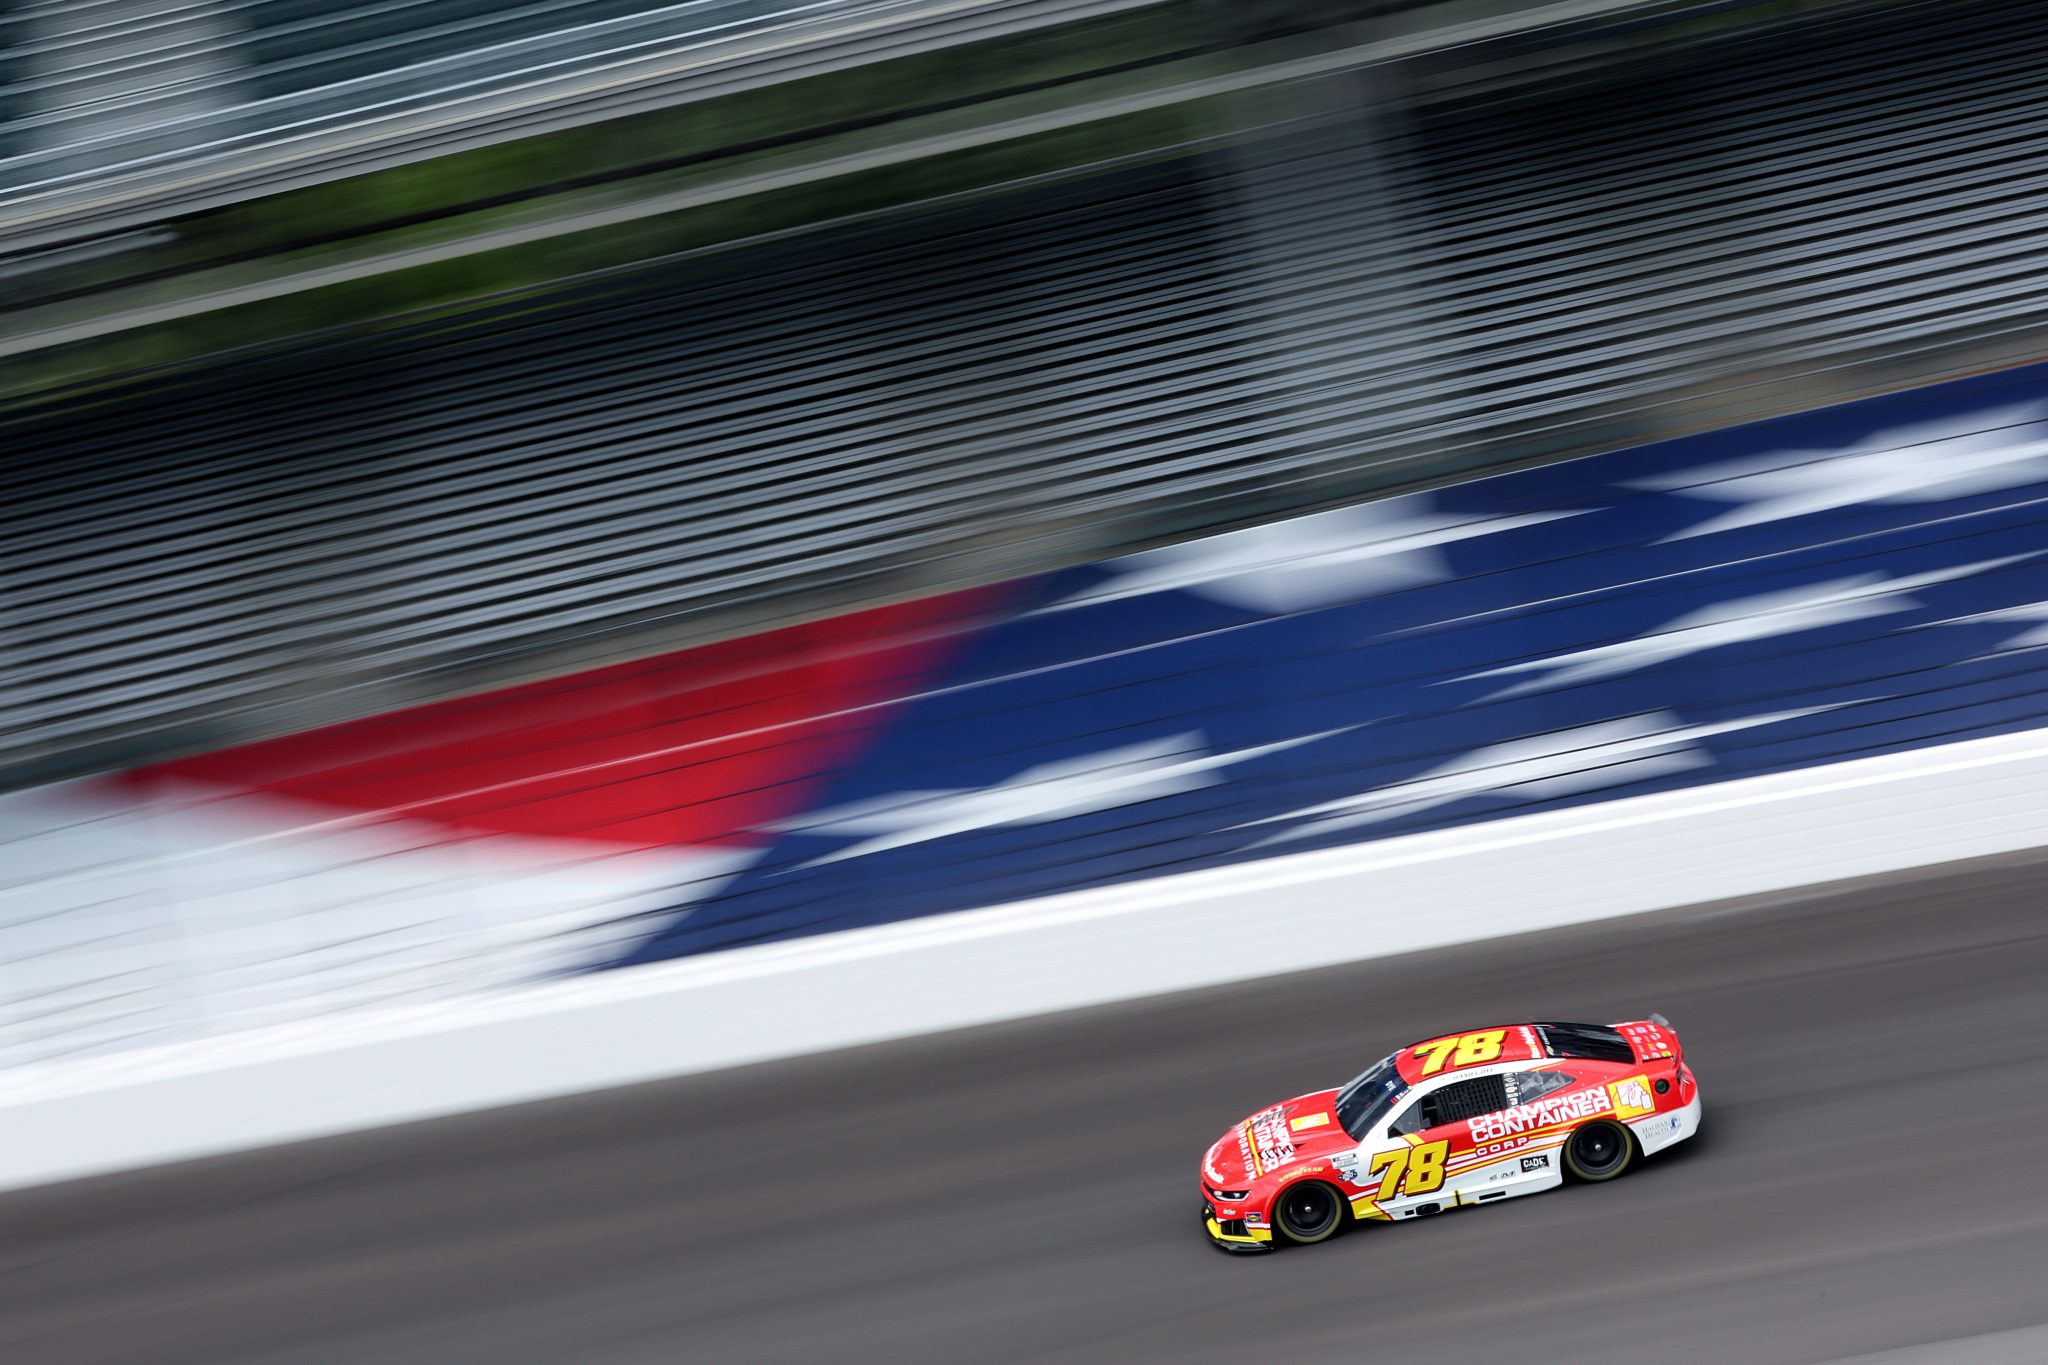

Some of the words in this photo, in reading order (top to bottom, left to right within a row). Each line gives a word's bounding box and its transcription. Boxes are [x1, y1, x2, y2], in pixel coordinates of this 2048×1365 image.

[1413, 1030, 1508, 1077] 78
[1467, 1086, 1607, 1130] CHAMPION
[1471, 1099, 1611, 1143] CONTAINER
[1476, 1136, 1528, 1155] CORP
[1369, 1139, 1451, 1203] 78
